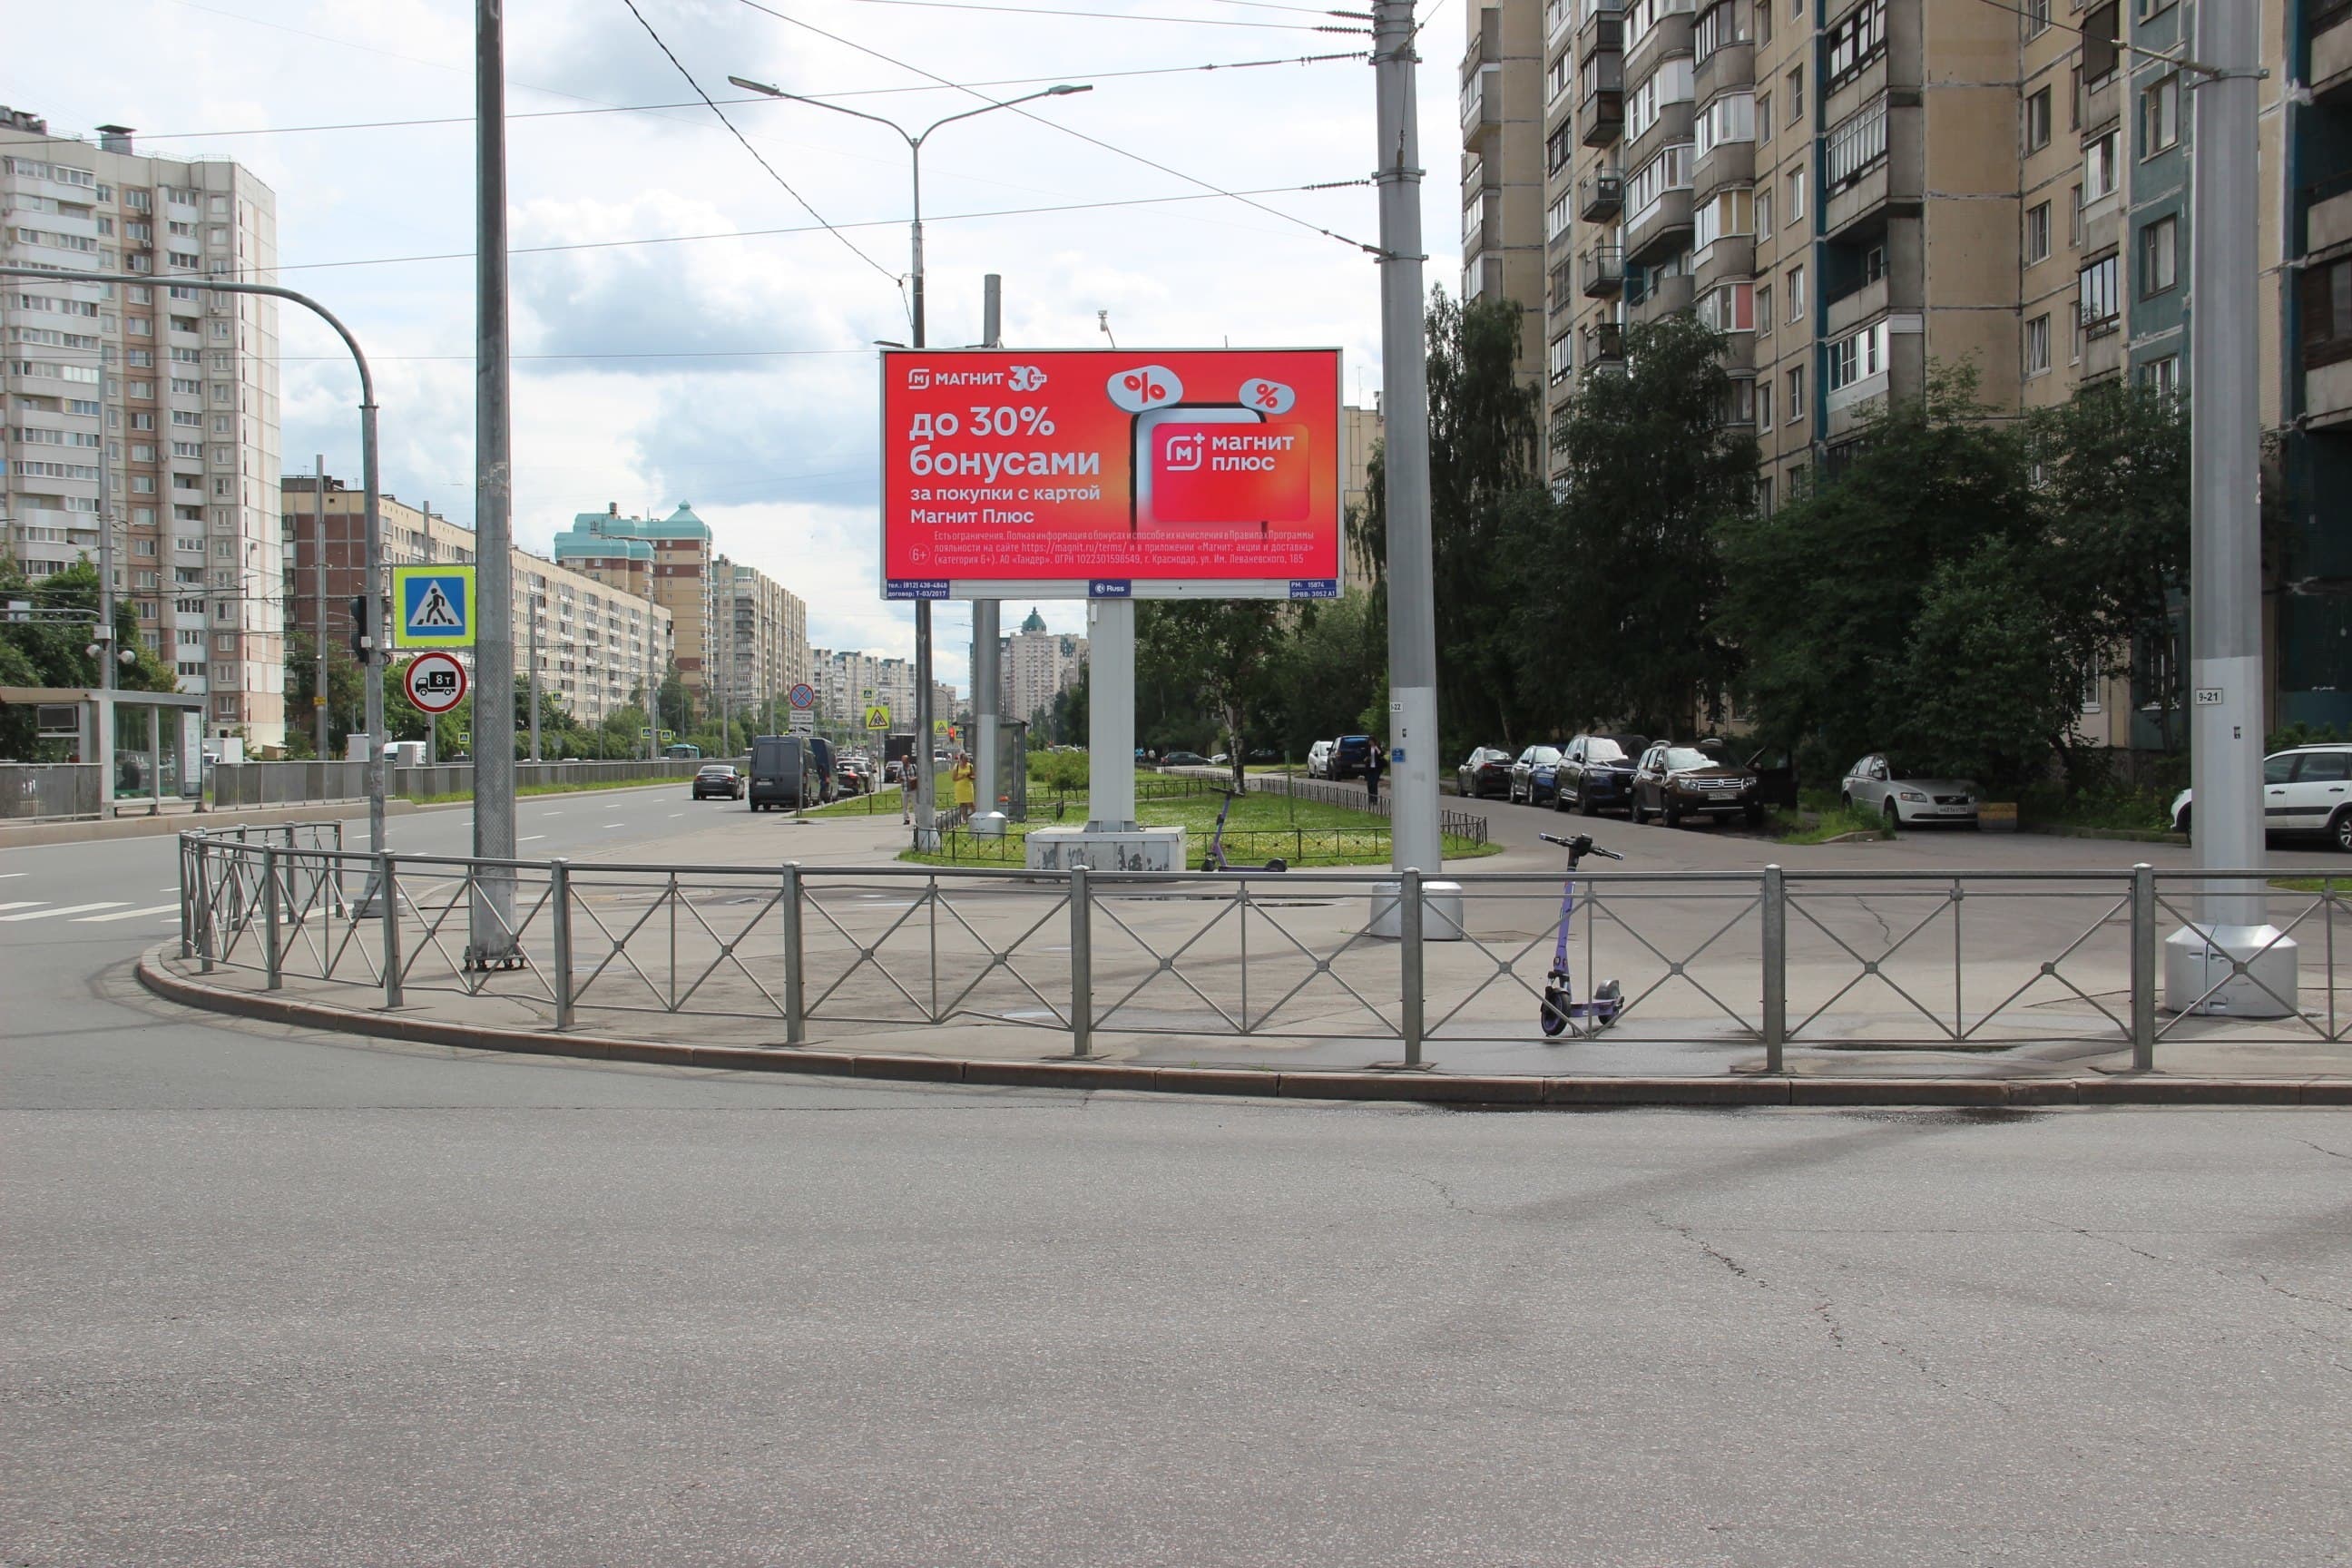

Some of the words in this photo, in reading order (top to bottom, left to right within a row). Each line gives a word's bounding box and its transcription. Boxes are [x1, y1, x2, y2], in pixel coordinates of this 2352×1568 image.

[936, 373, 1004, 386] МАГНИТ
[1007, 366, 1042, 391] 30
[909, 413, 959, 441] до
[969, 407, 1055, 436] 30%
[1212, 436, 1294, 450] магнит
[910, 444, 1100, 484] бонусами
[1212, 456, 1275, 471] плюс
[910, 488, 931, 501] за
[936, 488, 1013, 505] покупки
[1018, 488, 1029, 501] с
[1034, 485, 1100, 504] картой
[911, 509, 977, 524] Магнит
[983, 509, 1034, 524] Плюс
[935, 530, 952, 541] Есть
[1007, 531, 1034, 541] Полная
[1036, 530, 1087, 544] информация
[1269, 530, 1314, 542] Программы
[912, 548, 926, 561] 6+
[935, 544, 980, 553] лояльности
[984, 544, 993, 553] на
[995, 543, 1019, 553] сайте
[1145, 544, 1194, 554] приложении
[1237, 544, 1260, 554] акции
[1000, 554, 1009, 564] АО
[1054, 554, 1073, 564] ОГРН
[436, 674, 444, 685] 8
[2199, 692, 2219, 701] 9-21
